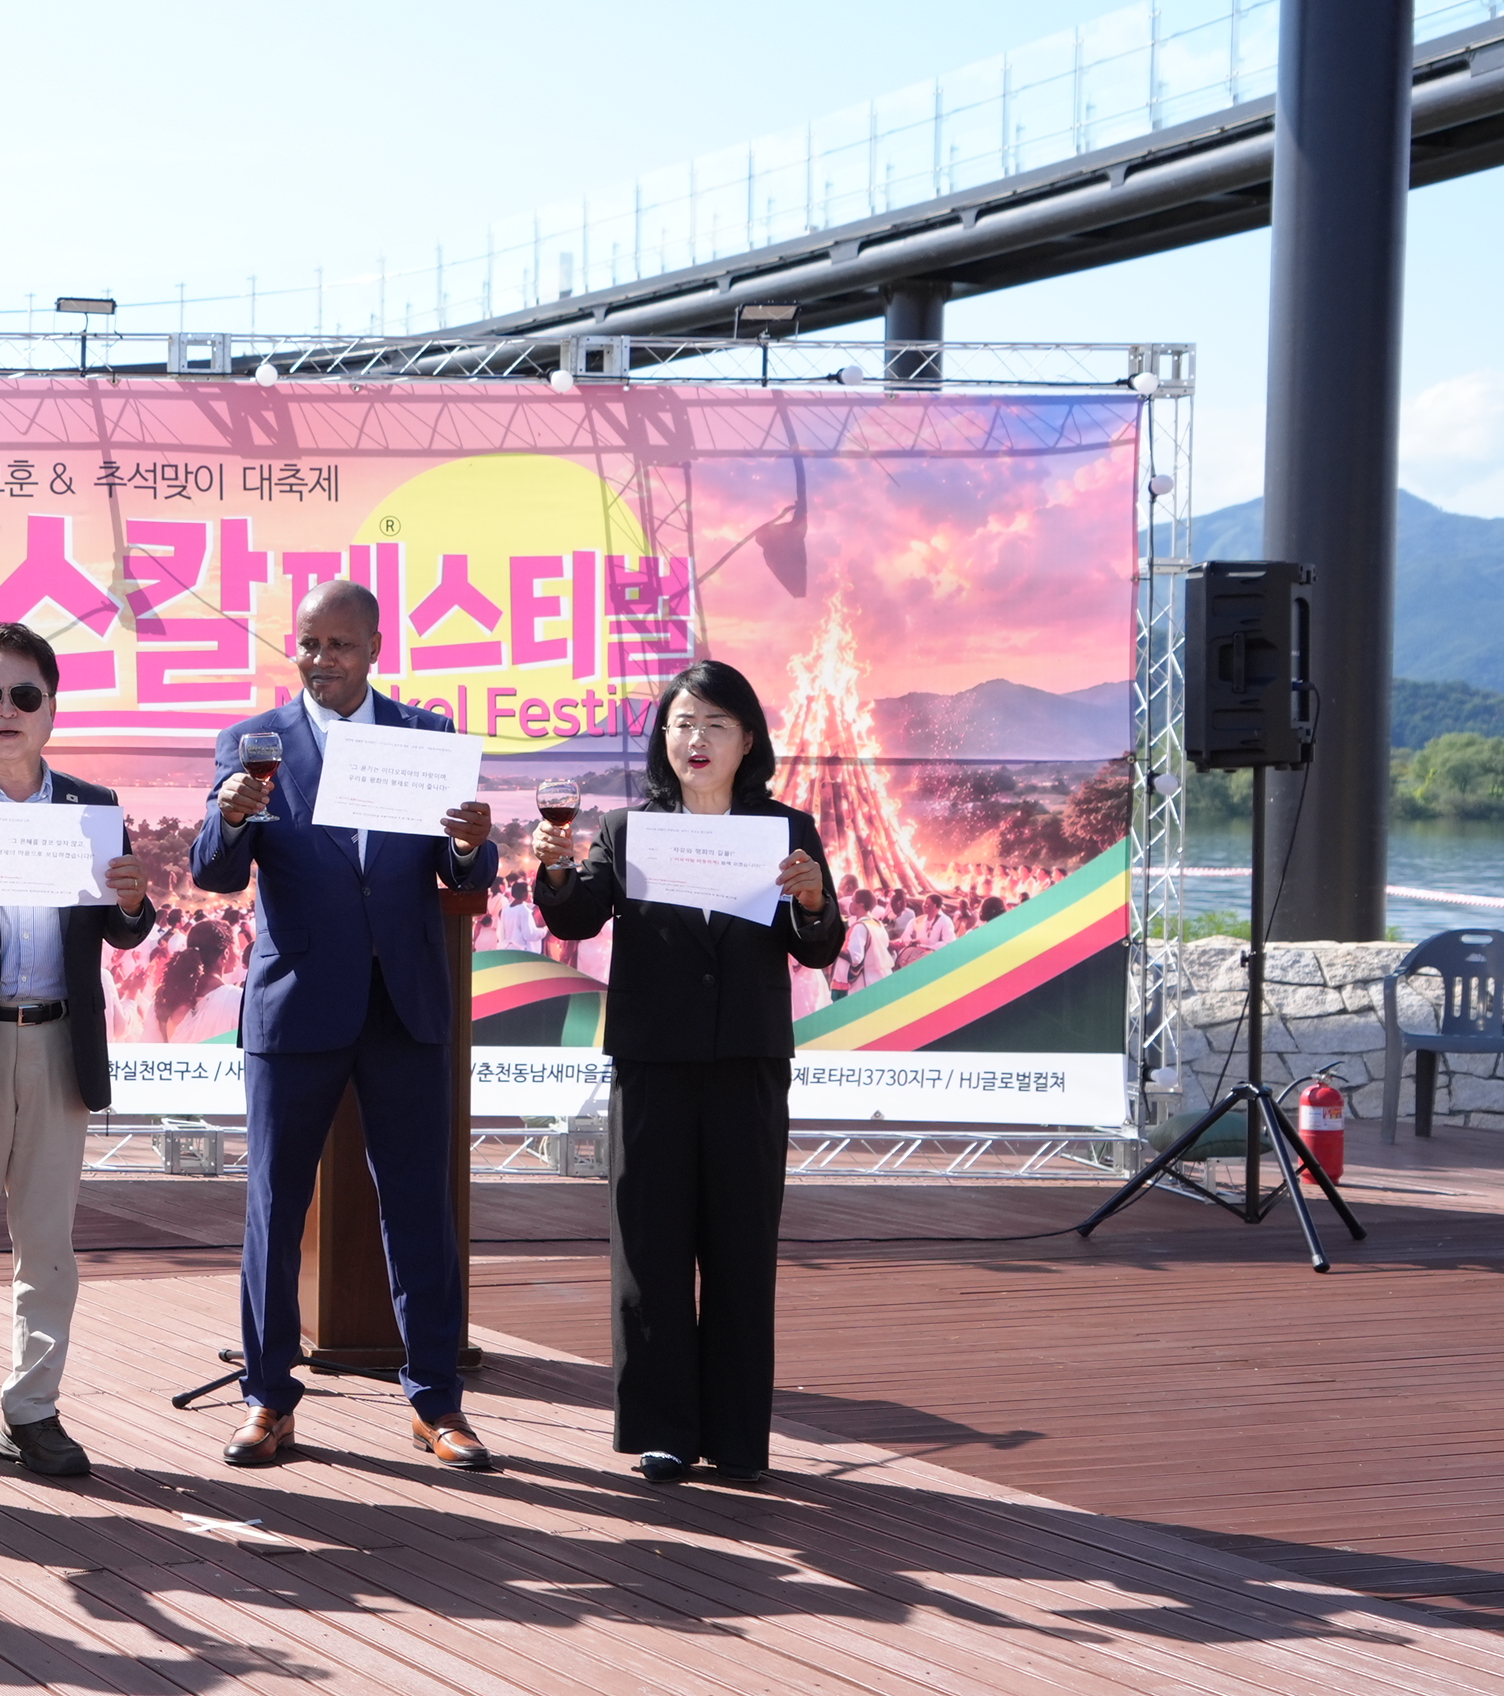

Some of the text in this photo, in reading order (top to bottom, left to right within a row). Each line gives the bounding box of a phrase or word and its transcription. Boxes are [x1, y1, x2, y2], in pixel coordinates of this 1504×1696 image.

[49, 462, 77, 495] &
[93, 460, 224, 501] 추석맞이
[242, 463, 339, 502] 대축제
[486, 684, 658, 738] Festiv
[792, 1067, 943, 1089] 제로타리3730지구
[959, 1071, 1066, 1093] HJ글로벌컬쳐
